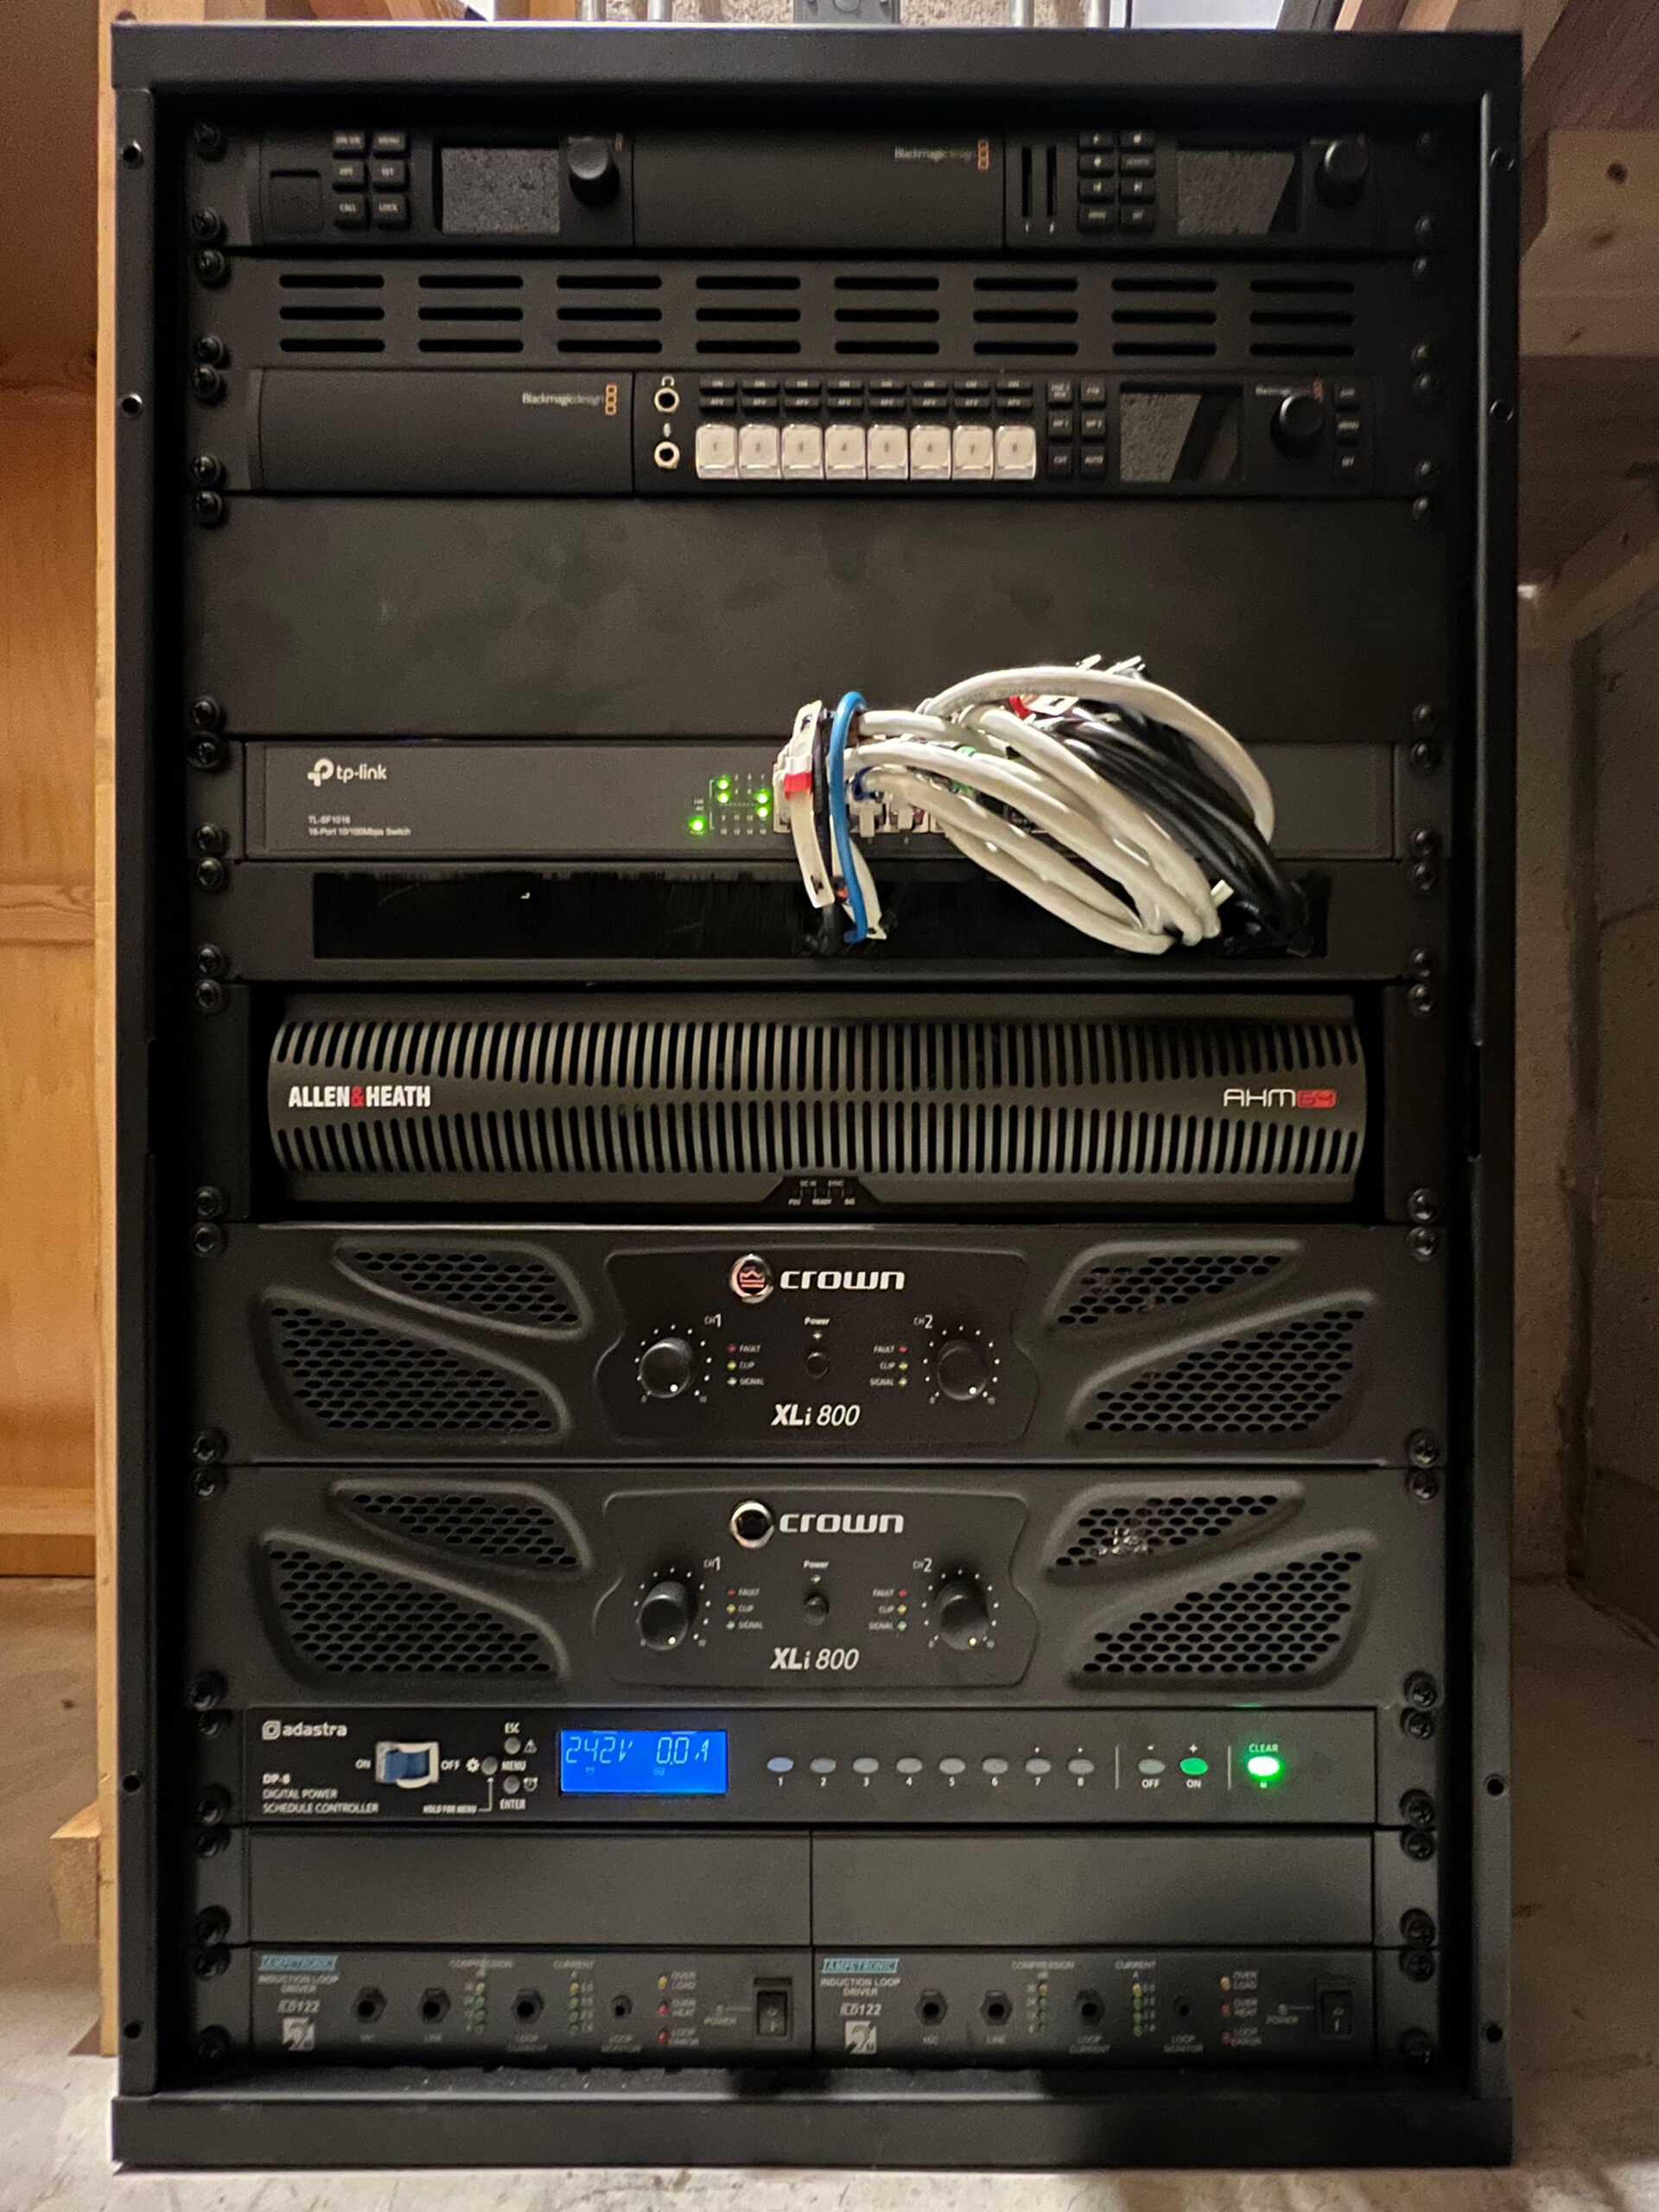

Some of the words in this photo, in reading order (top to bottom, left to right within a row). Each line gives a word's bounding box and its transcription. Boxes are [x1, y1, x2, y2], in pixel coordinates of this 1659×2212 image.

[336, 764, 387, 784] tp-link
[289, 1086, 431, 1108] ALLEN&HEATH
[780, 1271, 906, 1290] crown
[804, 1316, 830, 1325] Power
[739, 1361, 755, 1370] CLIP
[879, 1362, 896, 1370] CLIP
[771, 1403, 811, 1426] XLi
[816, 1404, 861, 1427] 800
[779, 1514, 905, 1534] crown
[804, 1560, 830, 1569] Power
[738, 1605, 754, 1613] CLIP
[878, 1605, 895, 1614] CLIP
[770, 1647, 810, 1670] XLi
[815, 1648, 860, 1671] 800
[282, 1721, 347, 1737] adastra
[504, 1722, 520, 1734] ESC
[1249, 1744, 1279, 1753] CLEAR
[355, 1758, 372, 1770] ON
[441, 1760, 461, 1770] OFF
[501, 1760, 527, 1771] MENU
[1141, 1779, 1160, 1789] OFF
[1186, 1779, 1202, 1789] ON
[263, 1789, 300, 1800] DIGITAL
[302, 1789, 338, 1800] POWER
[263, 1802, 314, 1814] SCHEDULE
[315, 1802, 379, 1814] CONTROLLER
[499, 1798, 526, 1810] ENTER
[1115, 1961, 1156, 1970] CURRENT
[821, 1978, 873, 1986] INDUCTION
[874, 1978, 901, 1986] LOOP
[842, 1988, 879, 1997] DRIVER
